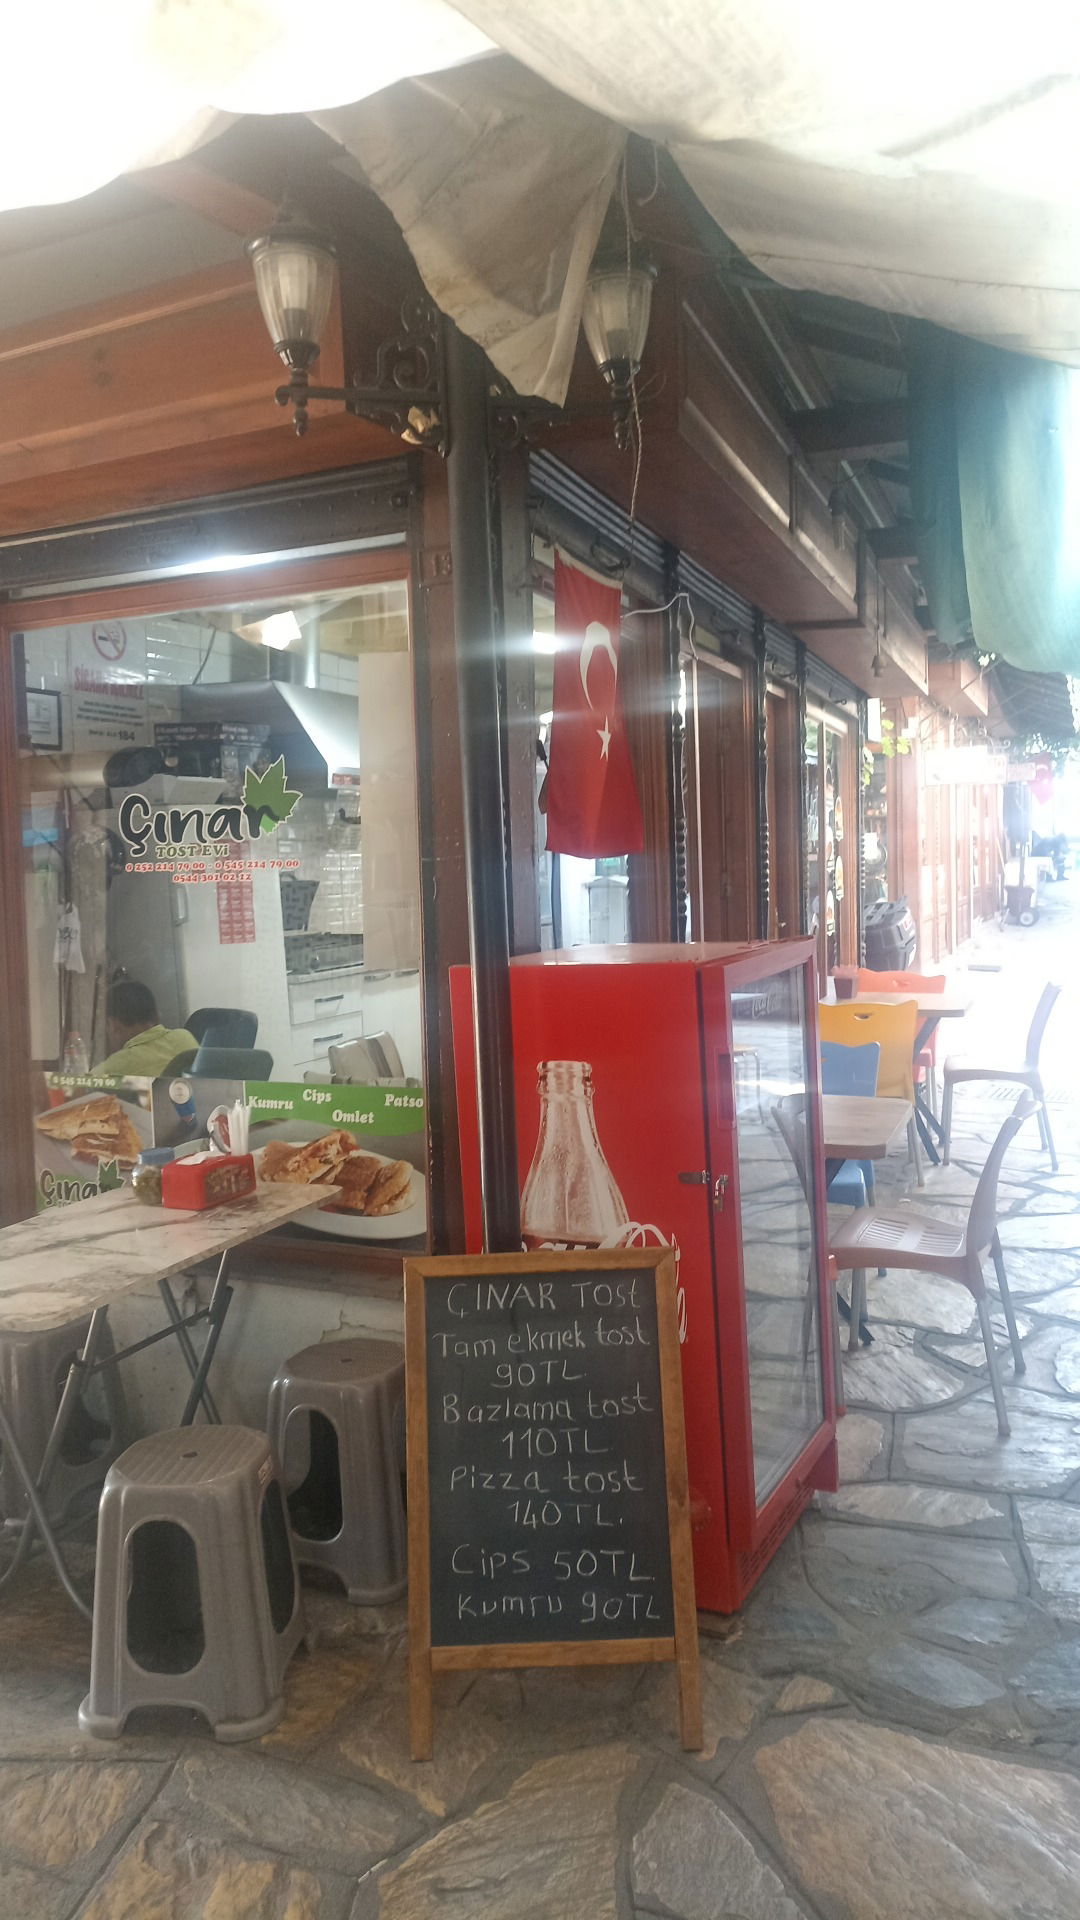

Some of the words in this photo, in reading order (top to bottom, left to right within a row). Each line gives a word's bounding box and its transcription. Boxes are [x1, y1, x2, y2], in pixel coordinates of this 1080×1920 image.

[119, 794, 280, 856] Çınar
[155, 846, 198, 858] TOST
[125, 862, 133, 872] 0
[135, 862, 154, 872] 252
[155, 861, 175, 872] 214
[176, 861, 190, 872] 79
[192, 861, 206, 871] 00
[215, 861, 222, 870] 0
[224, 860, 244, 871] 545
[247, 860, 266, 870] 214
[269, 859, 284, 870] 79
[285, 859, 299, 868] 00
[172, 873, 198, 883] 0544
[201, 873, 220, 883] 301
[223, 872, 239, 882] 02
[240, 872, 253, 881] 12
[60, 1076, 75, 1085] 545
[248, 1095, 294, 1110] Kumru
[384, 1093, 424, 1108] Patso
[303, 1088, 332, 1104] Cips
[332, 1109, 375, 1124] Omlet
[447, 1283, 556, 1318] ÇINAR
[432, 1333, 496, 1357] Tam
[508, 1321, 586, 1353] ekmek
[595, 1315, 650, 1346] tost
[442, 1393, 575, 1424] Bazlama
[588, 1382, 654, 1419] tost
[450, 1465, 549, 1493] Pizza
[563, 1460, 644, 1493] tost
[452, 1544, 530, 1579] Cips
